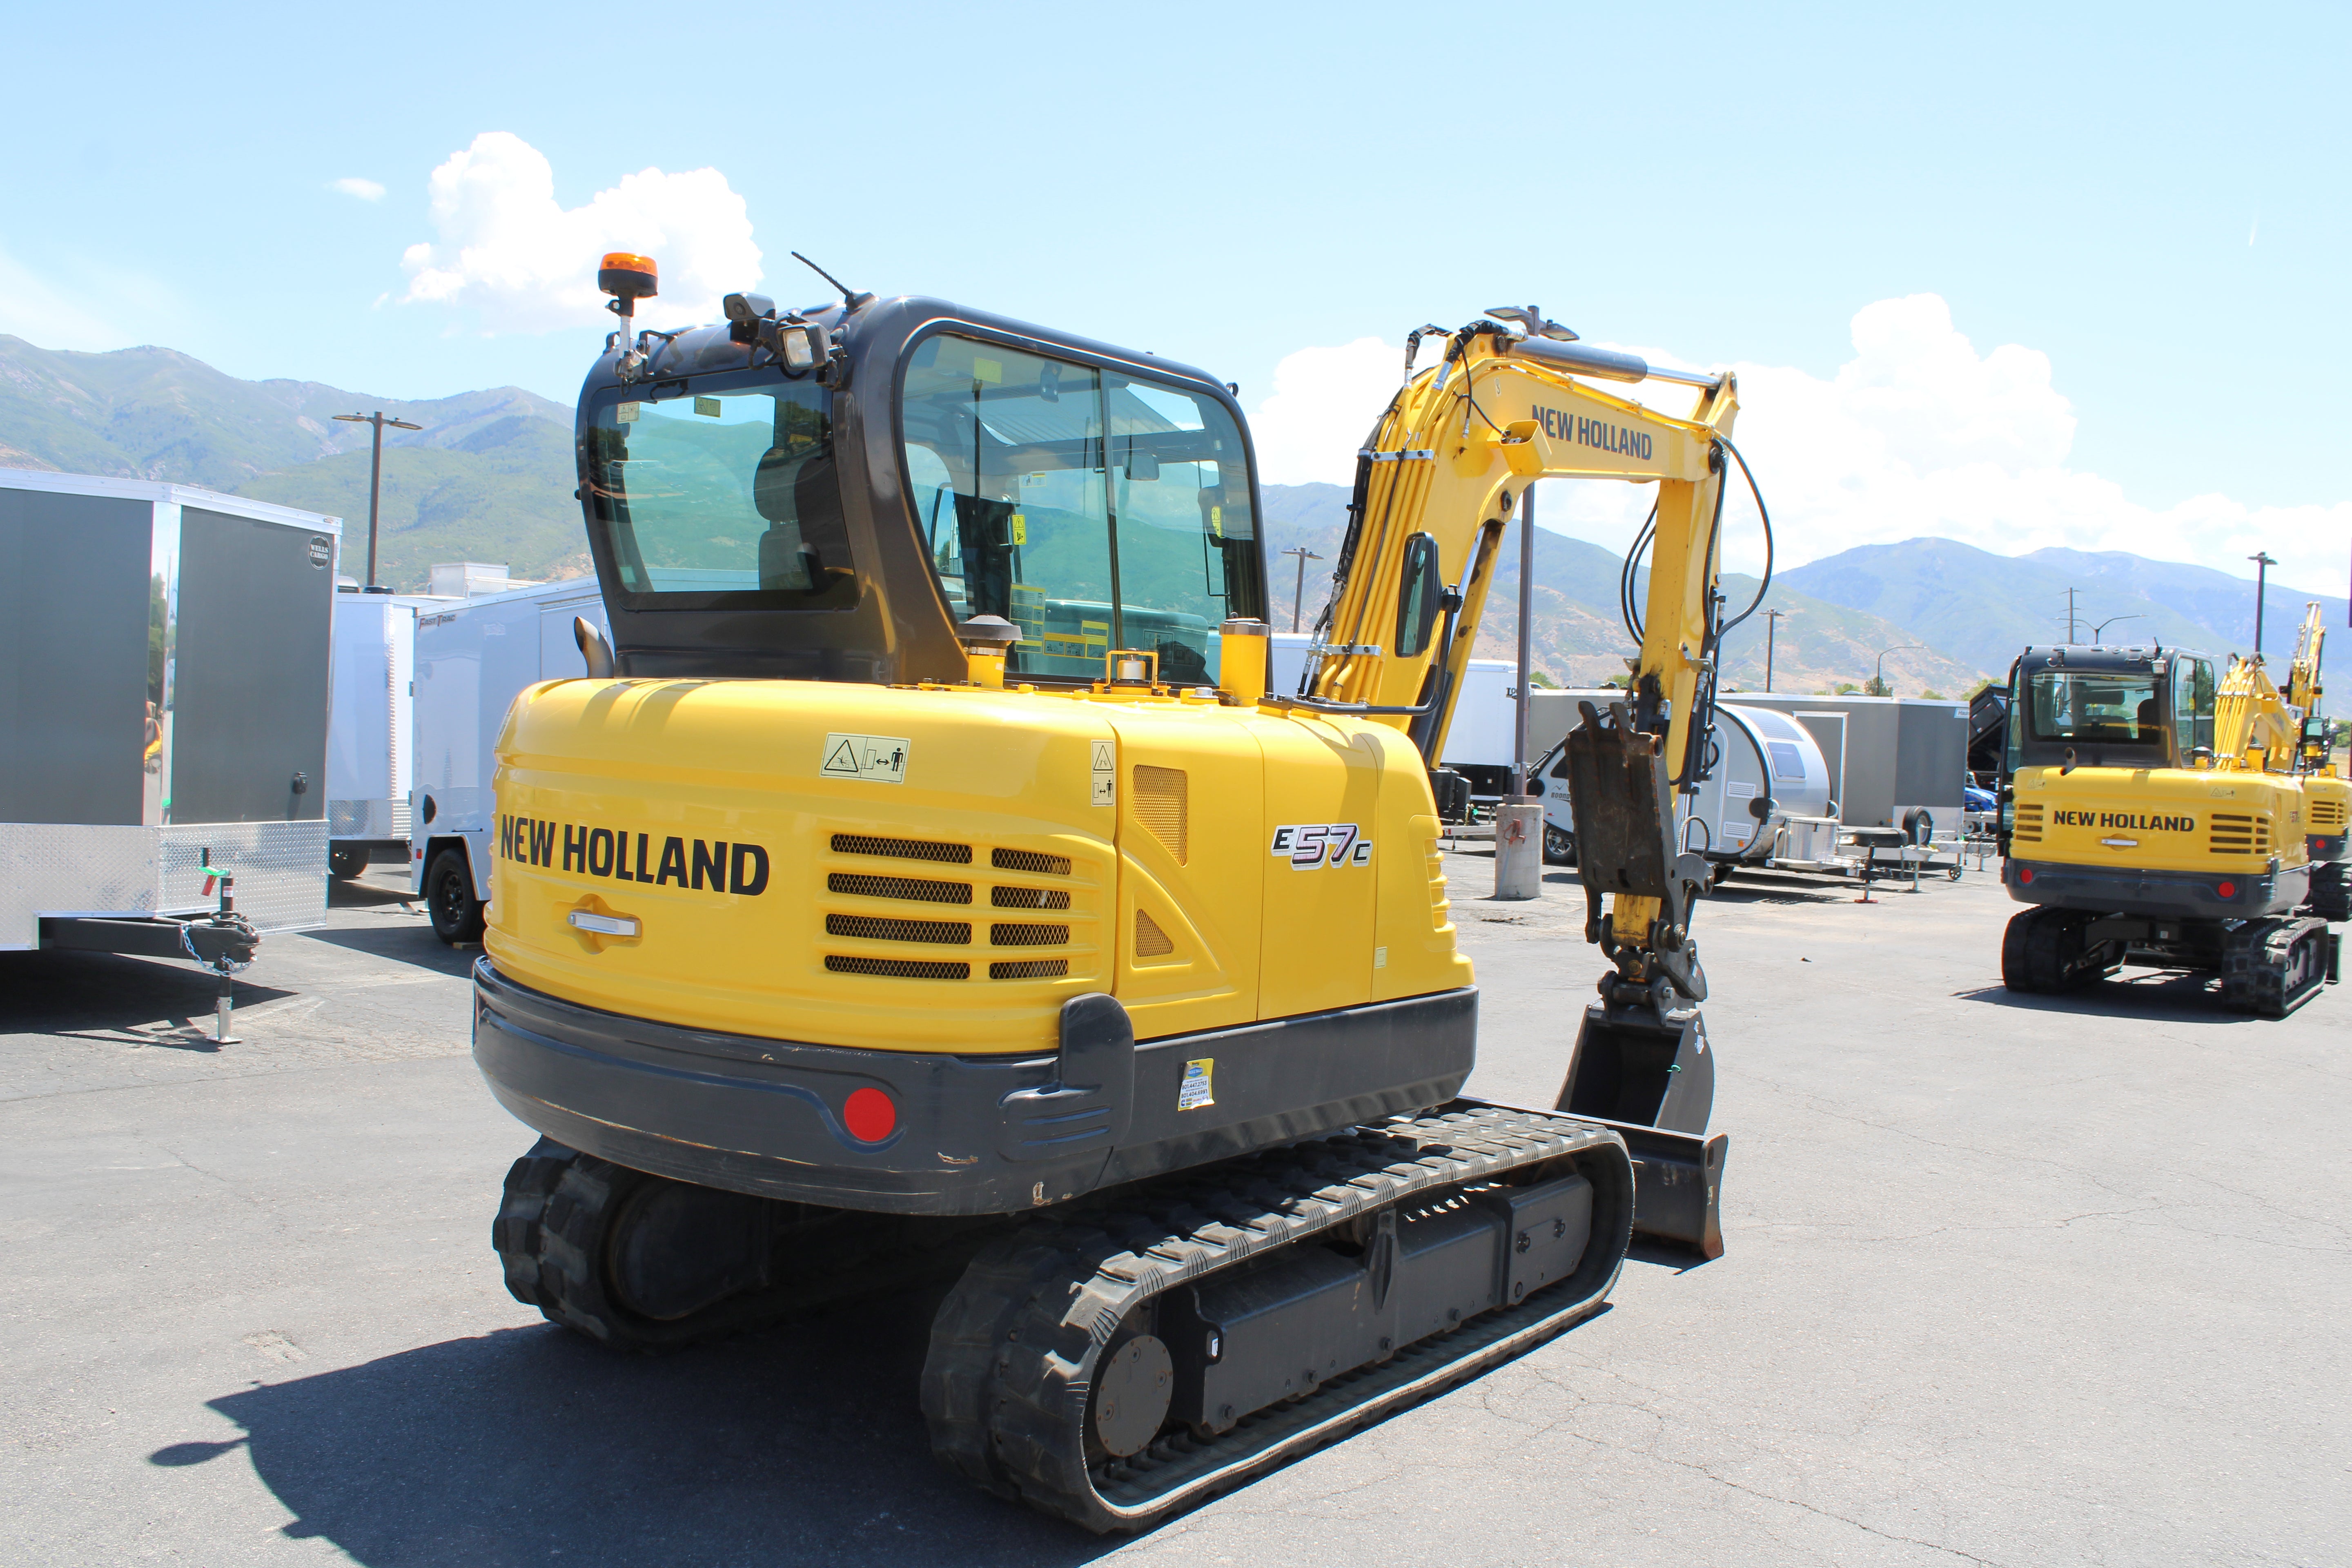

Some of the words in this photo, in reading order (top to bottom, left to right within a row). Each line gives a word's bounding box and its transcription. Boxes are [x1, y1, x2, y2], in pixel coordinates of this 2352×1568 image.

[1532, 404, 1573, 442] NEW
[1578, 416, 1652, 461] HOLLAND
[310, 544, 329, 553] WELLS
[310, 551, 329, 560] CARGO
[2054, 811, 2096, 826] NEW
[2100, 813, 2194, 832] HOLLAND
[501, 814, 556, 868] NEW
[563, 824, 769, 896] HOLLAND
[1182, 1080, 1207, 1090] 801.447.2753
[1181, 1089, 1207, 1098] 801.404.6991
